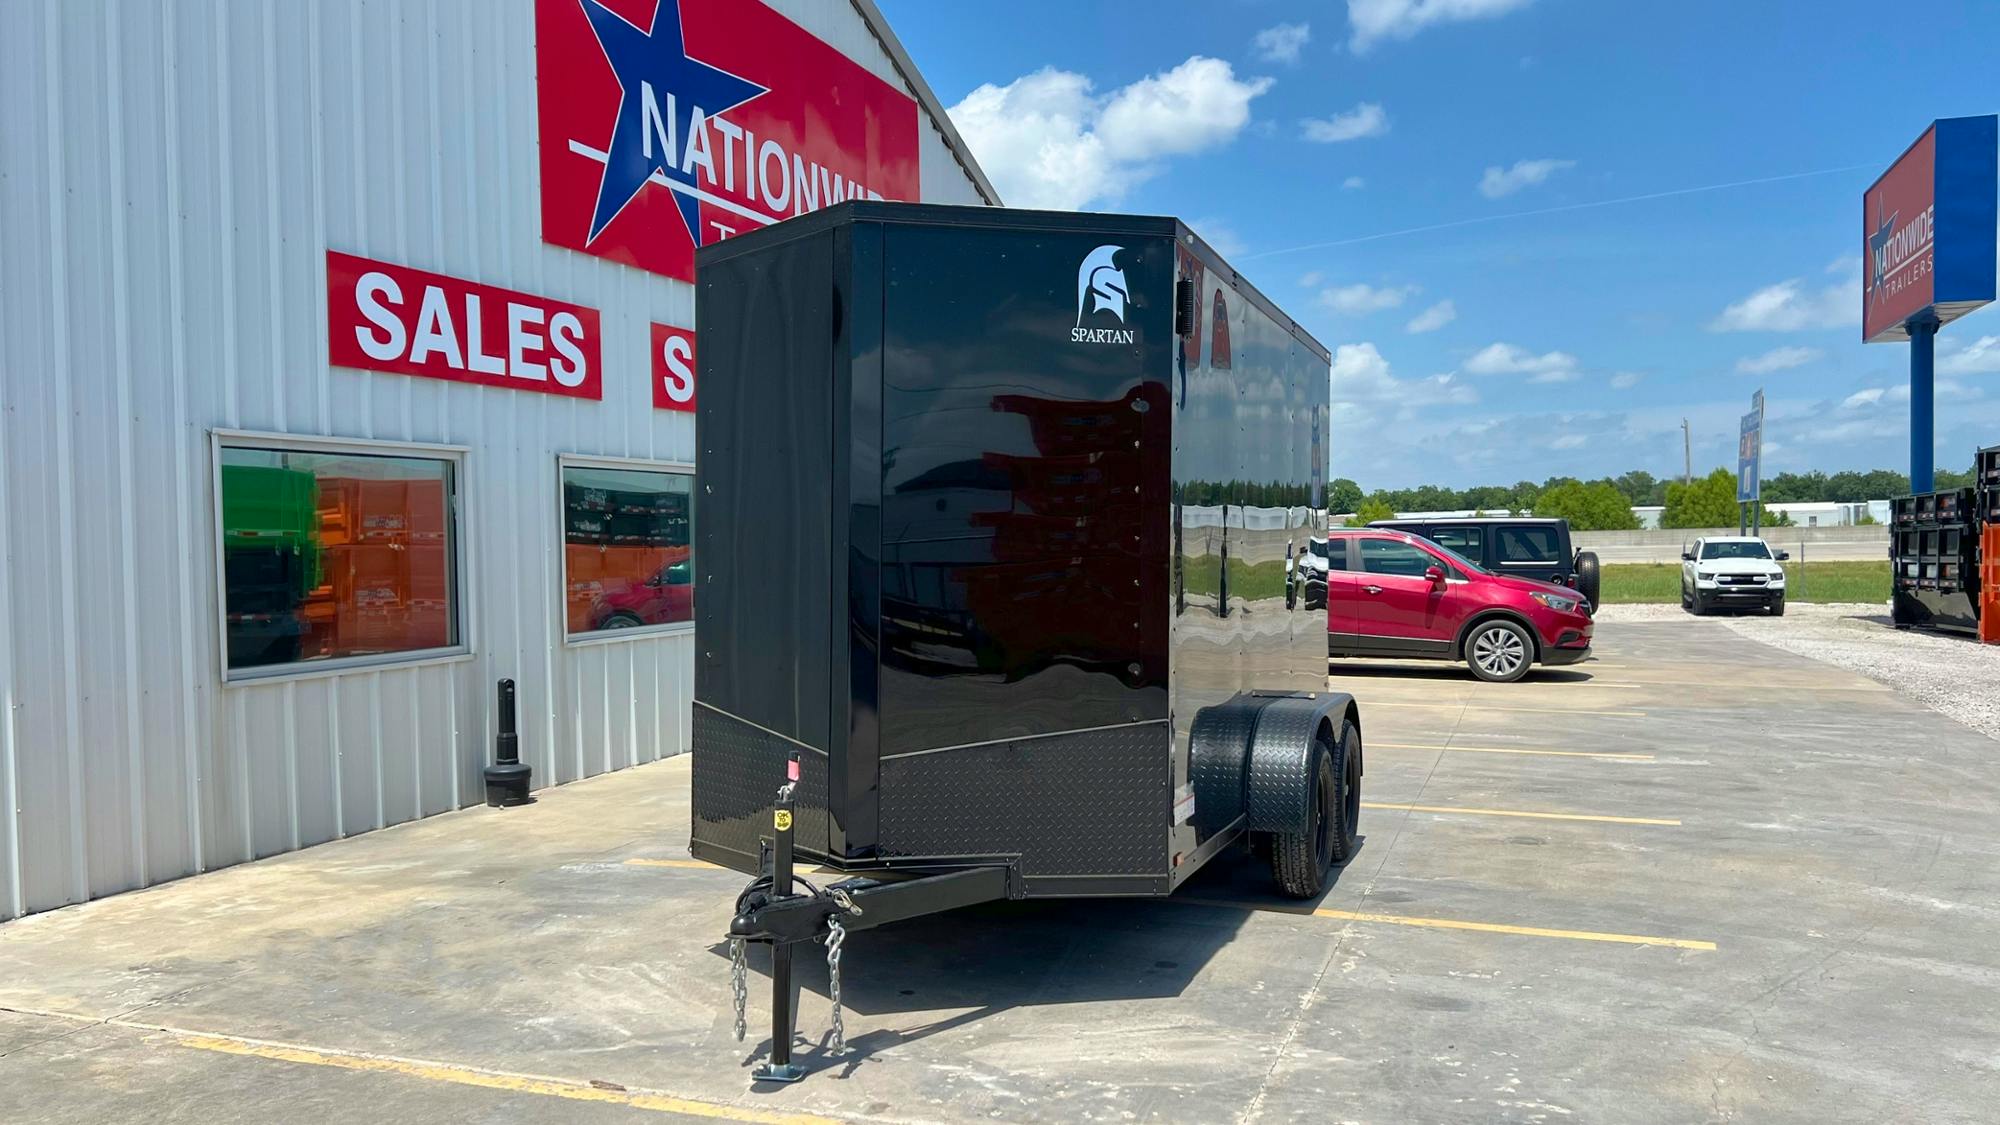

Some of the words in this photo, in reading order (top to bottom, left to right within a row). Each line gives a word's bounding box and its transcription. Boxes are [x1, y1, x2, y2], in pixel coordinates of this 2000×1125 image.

[1875, 204, 1935, 278] NATIONWIDE
[1885, 253, 1934, 300] TRAILERS
[354, 271, 587, 388] SALES
[1071, 327, 1134, 344] SPARTAN
